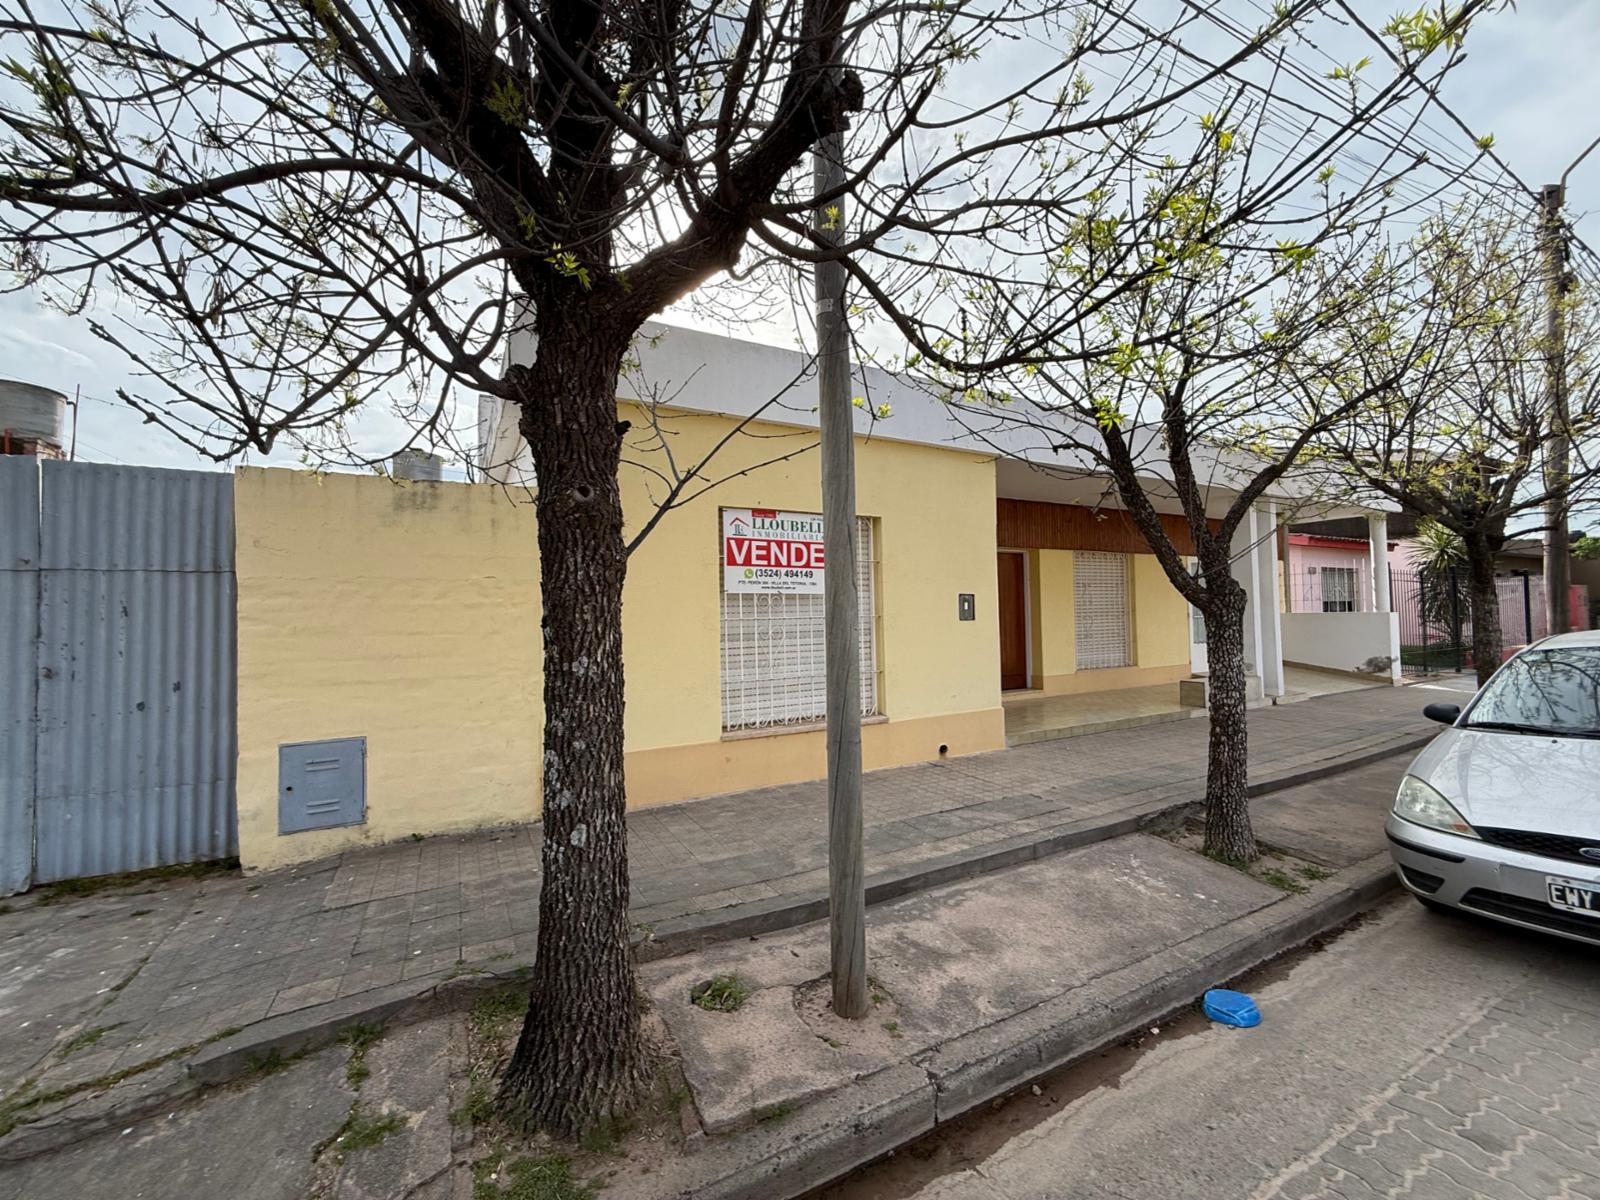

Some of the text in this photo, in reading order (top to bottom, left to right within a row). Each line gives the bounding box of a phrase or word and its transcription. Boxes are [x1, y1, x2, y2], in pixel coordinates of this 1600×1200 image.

[729, 539, 825, 567] VENDE
[755, 568, 814, 579] (3524) 494149
[1550, 884, 1592, 909] EWY
